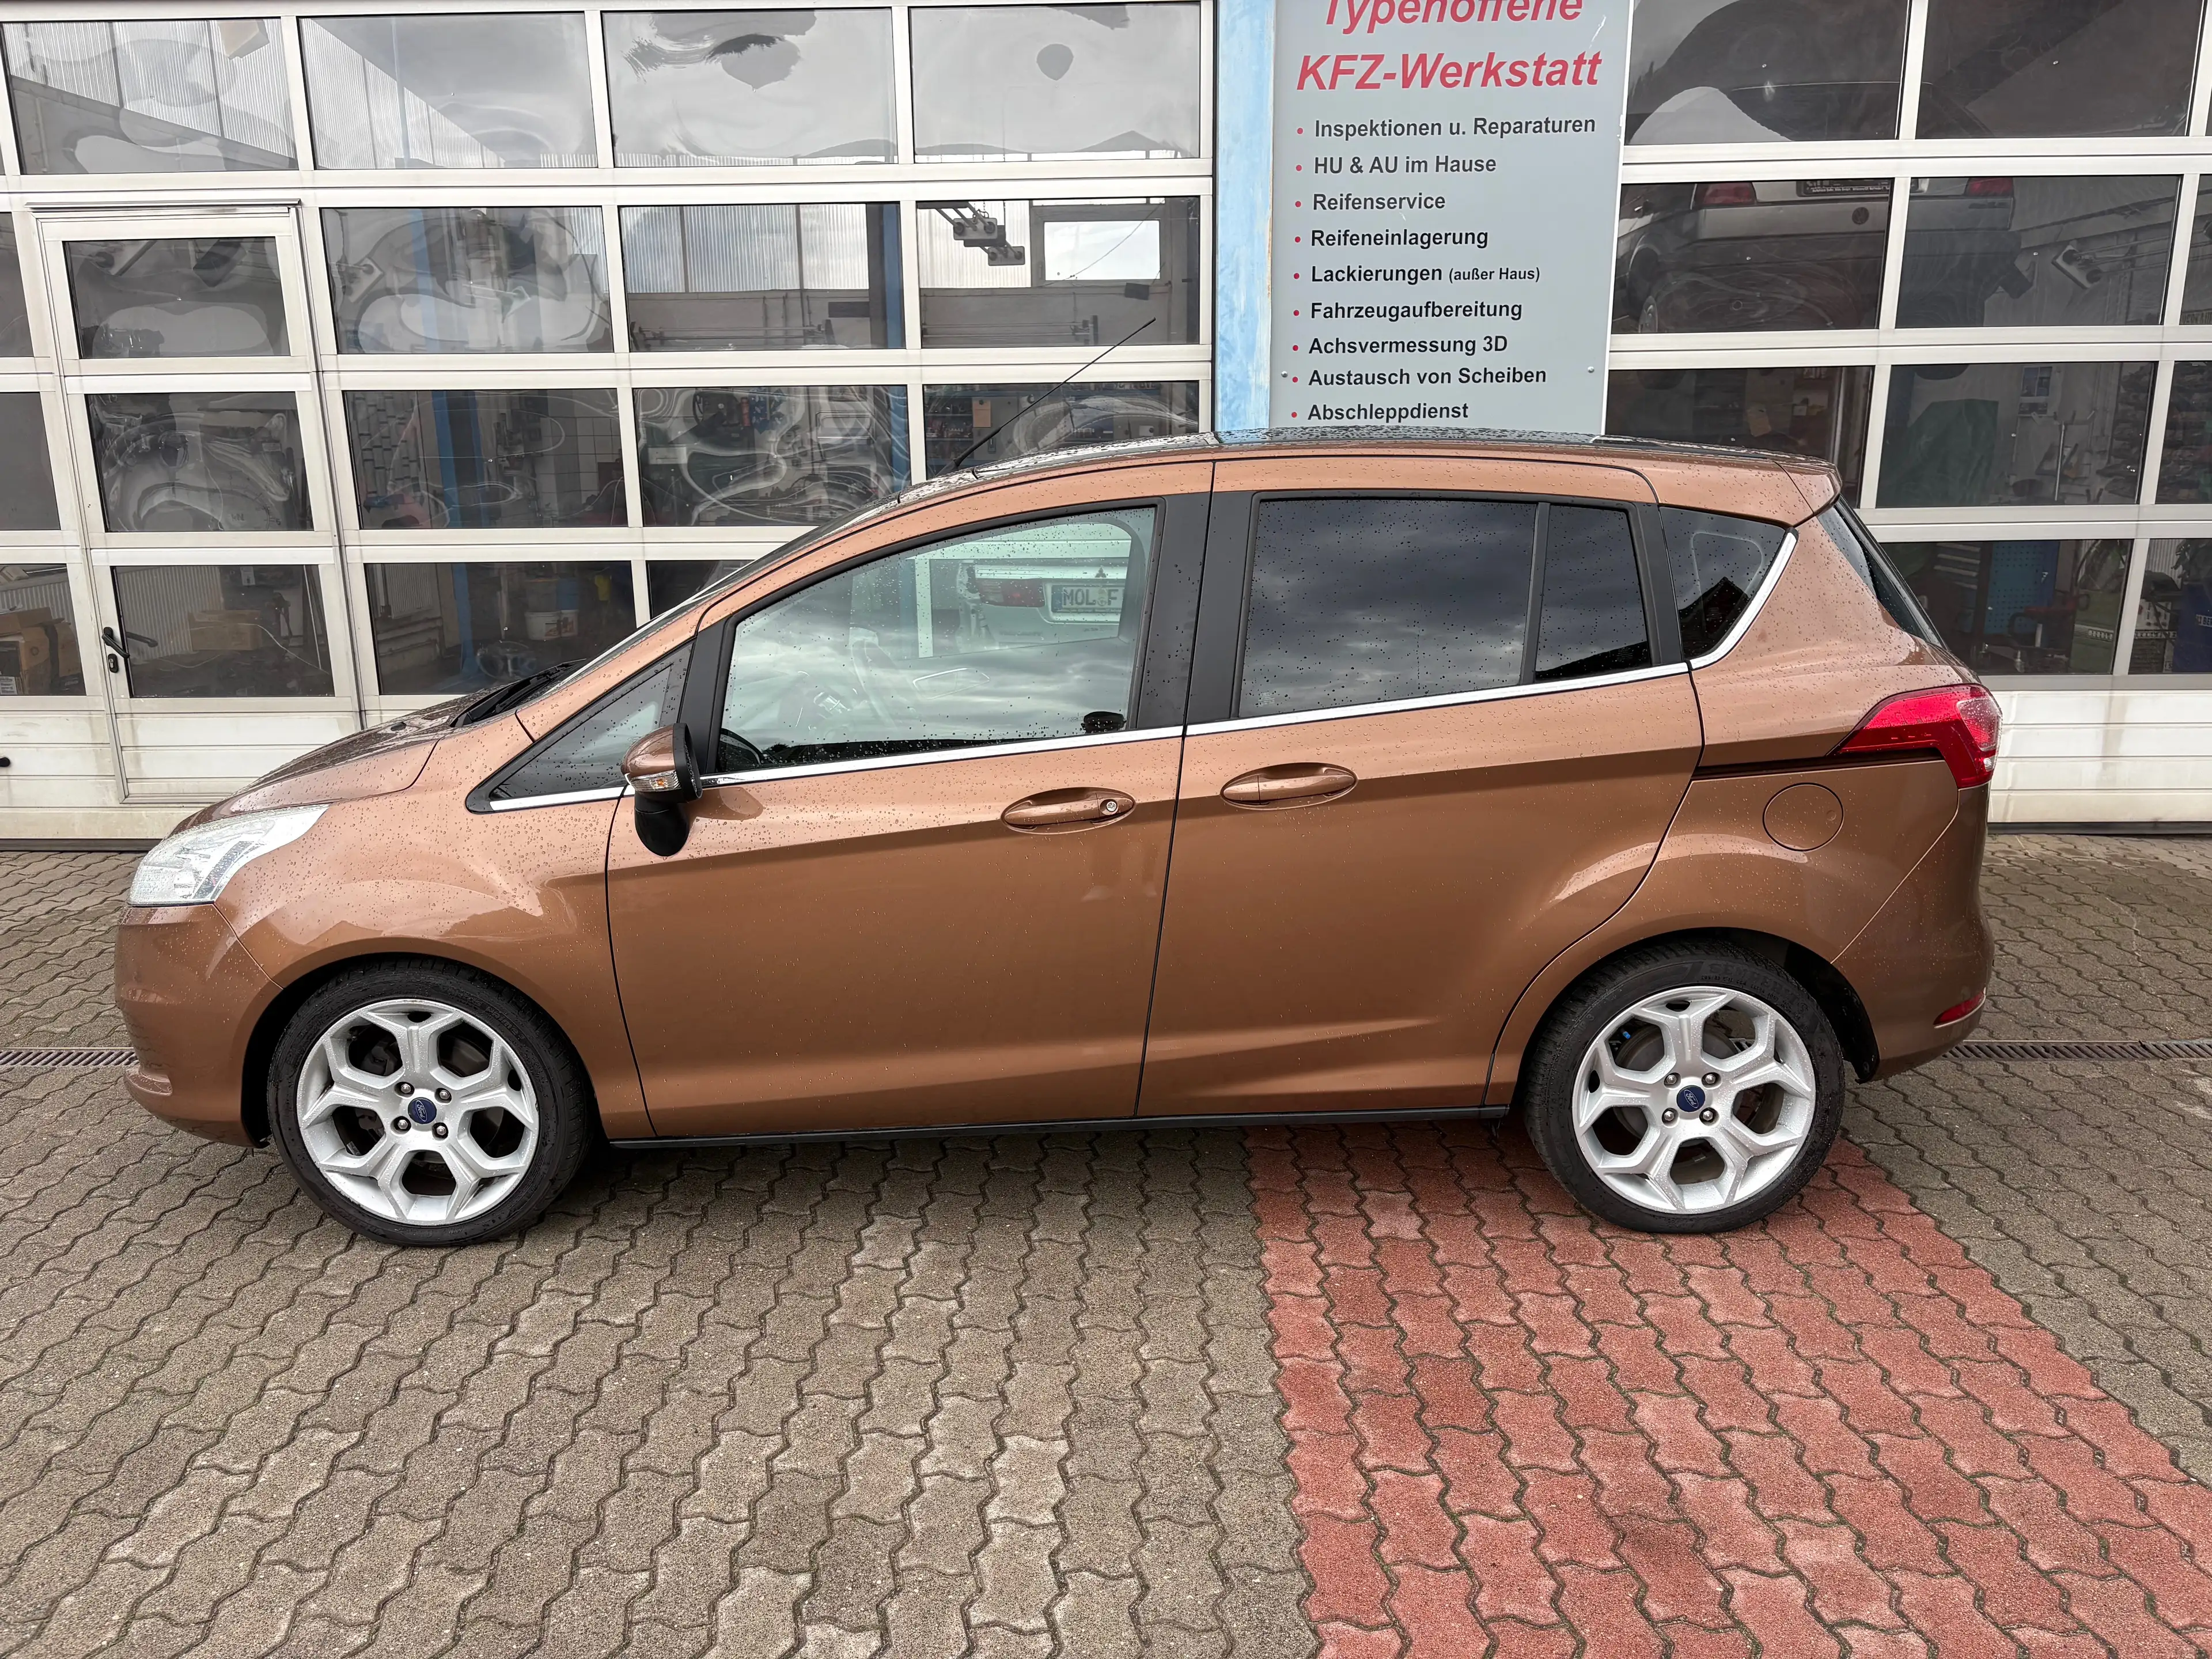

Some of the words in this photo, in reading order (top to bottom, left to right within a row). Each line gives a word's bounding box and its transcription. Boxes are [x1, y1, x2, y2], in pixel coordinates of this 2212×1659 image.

[1325, 0, 1582, 35] Typenoffene
[1297, 51, 1603, 90] KFZ-Werkstatt
[1315, 119, 1441, 141] Inspektionen
[1449, 123, 1465, 135] u.
[1474, 117, 1595, 138] Reparaturen
[1315, 157, 1342, 173] HU
[1350, 156, 1363, 173] &
[1369, 156, 1398, 173] AU
[1406, 156, 1428, 173] im
[1435, 155, 1497, 172] Hause
[1313, 192, 1445, 210] Reifenservice
[1311, 229, 1488, 249] Reifeneinlagerung
[1312, 266, 1441, 285] Lackierungen
[1449, 268, 1495, 283] (außer
[1499, 267, 1540, 282] Haus)
[1311, 301, 1522, 322] Fahrzeugaufbereitung
[1309, 338, 1476, 356] Achsvermessung
[1483, 335, 1508, 352] 3D
[1309, 369, 1410, 385] Austausch
[1416, 372, 1451, 384] von
[1458, 367, 1546, 384] Scheiben
[1308, 403, 1469, 423] Abschleppdienst
[1063, 588, 1096, 605] MOL
[1107, 589, 1124, 605] F
[1684, 1092, 1698, 1106] Ford
[415, 1103, 426, 1119] Ford
